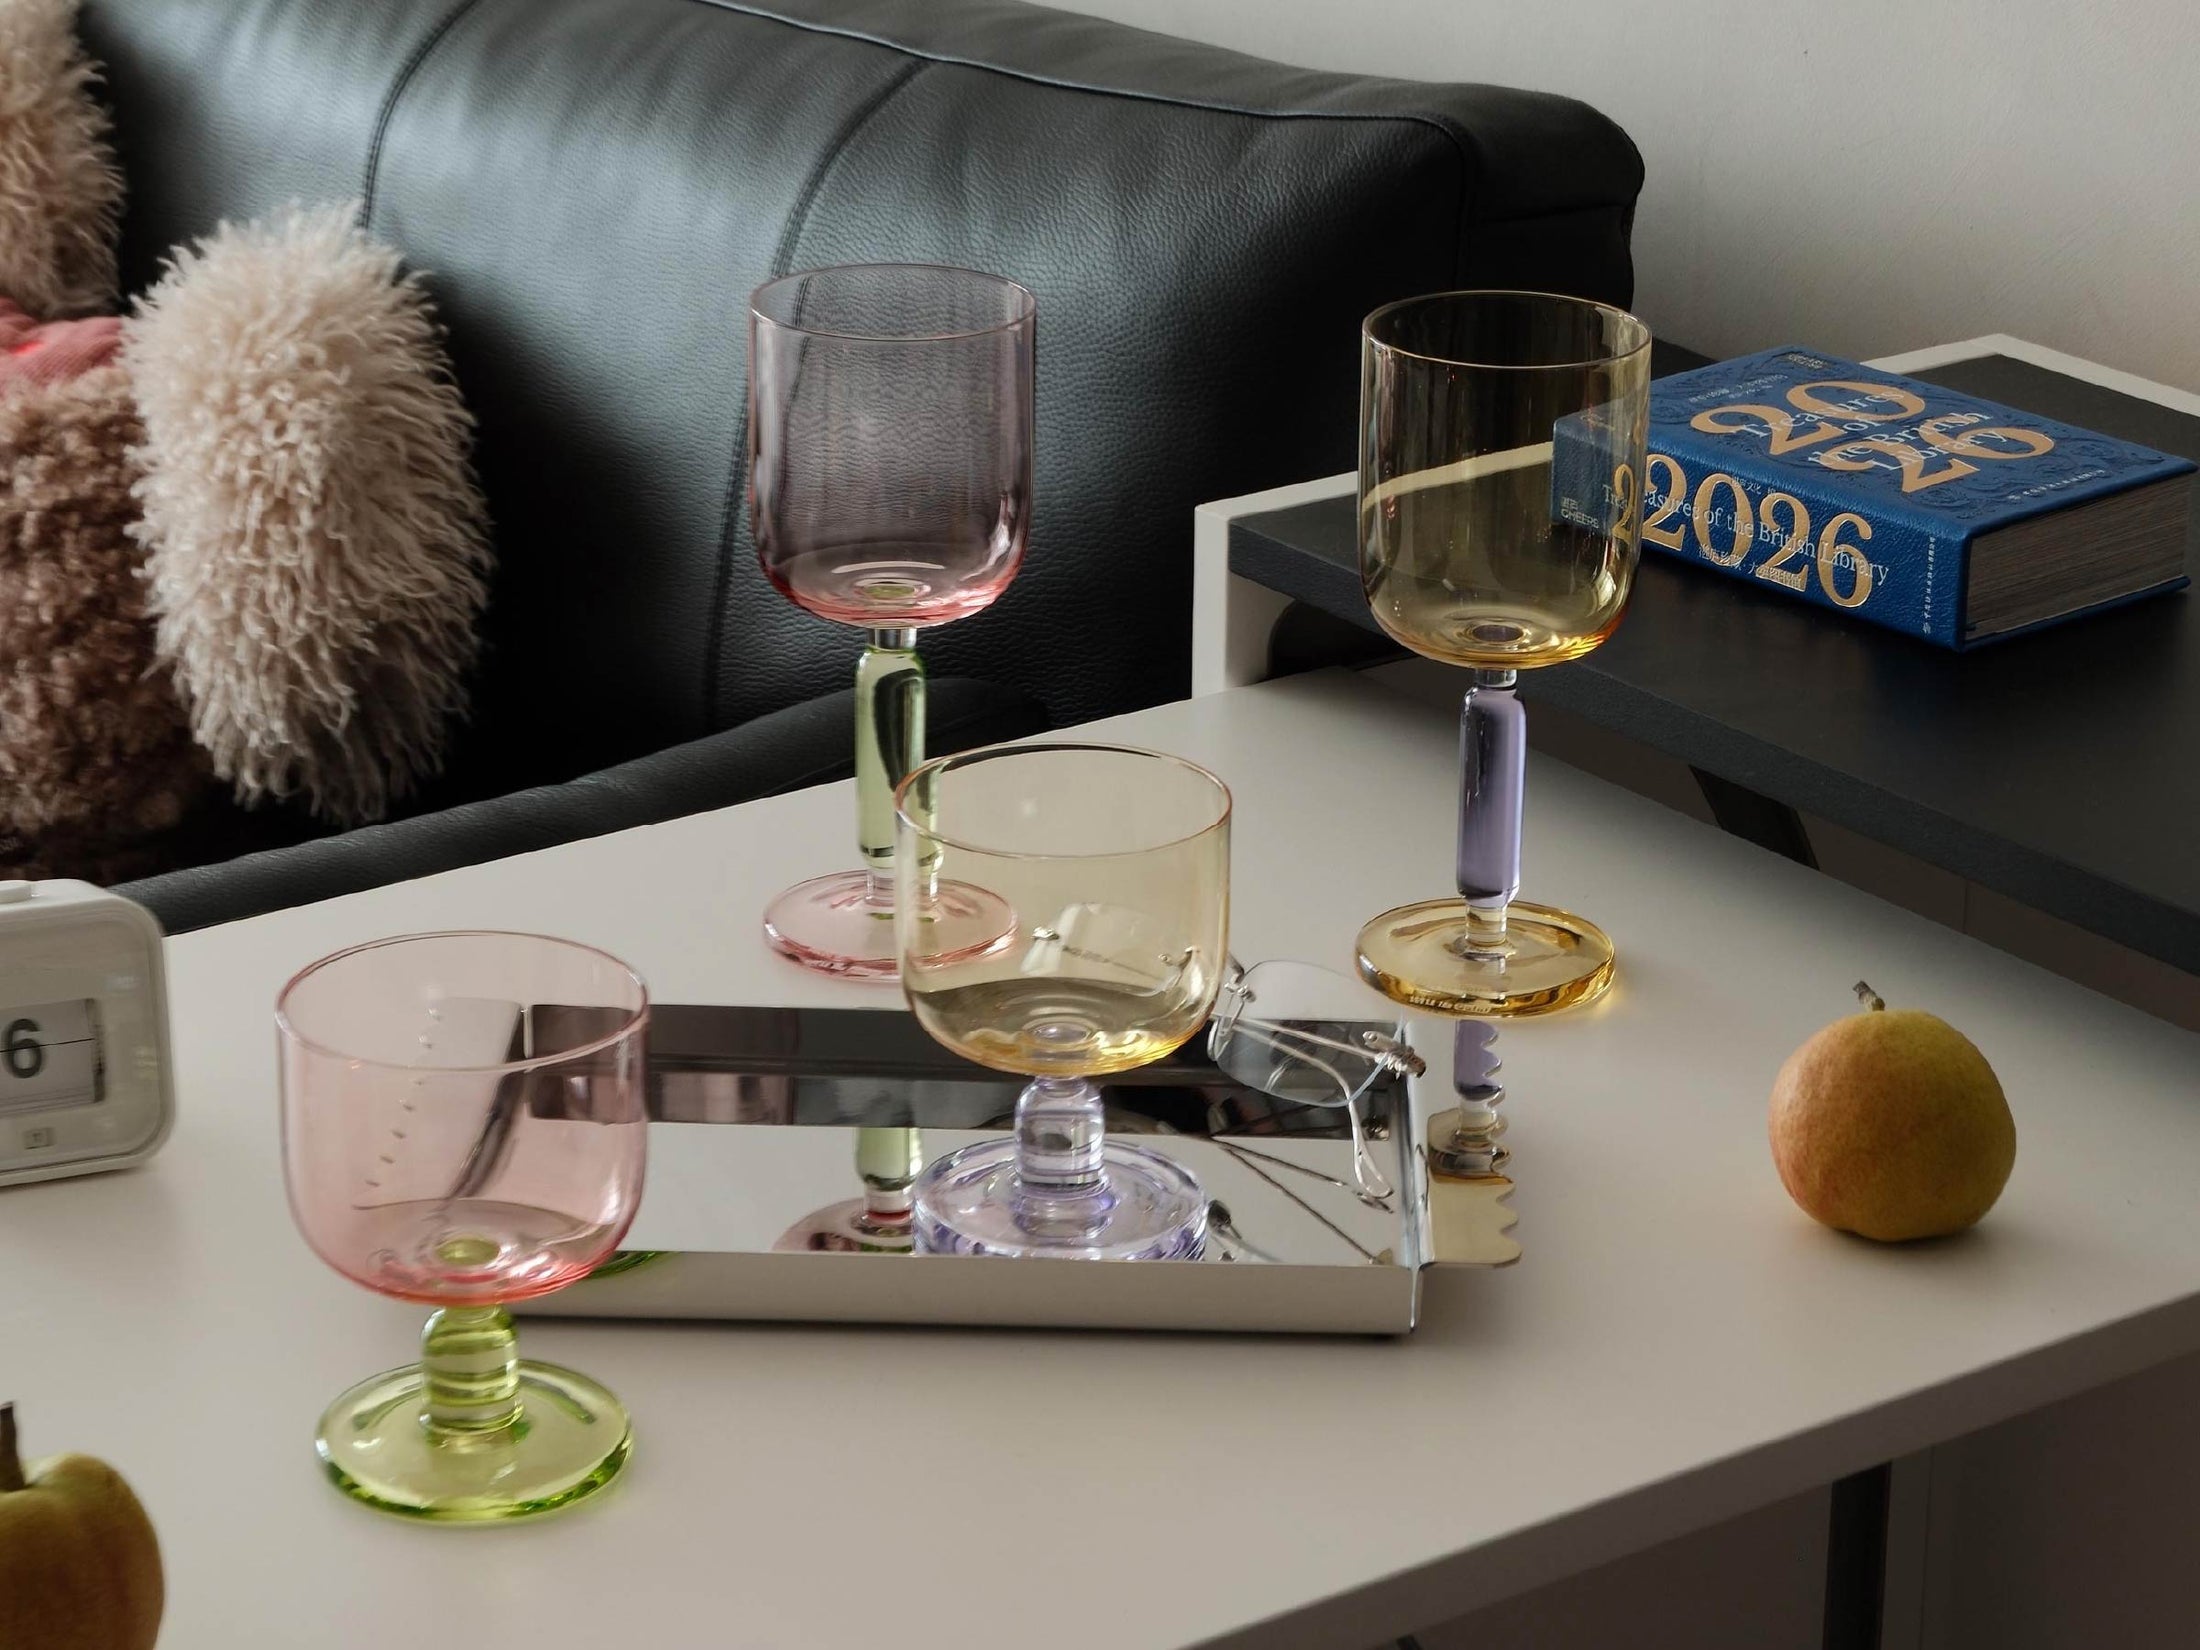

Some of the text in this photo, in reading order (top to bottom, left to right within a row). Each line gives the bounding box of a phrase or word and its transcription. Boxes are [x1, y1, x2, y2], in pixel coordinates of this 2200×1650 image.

[1738, 390, 1905, 437] Treasures
[1808, 411, 1992, 466] the British
[1841, 415, 1881, 434] of
[1870, 429, 2007, 471] Library
[1641, 454, 1873, 608] 2026
[1703, 504, 1723, 527] of
[1726, 511, 1754, 538] the
[1759, 521, 1816, 559] British
[1820, 541, 1889, 588] Library
[3, 1018, 43, 1079] 6
